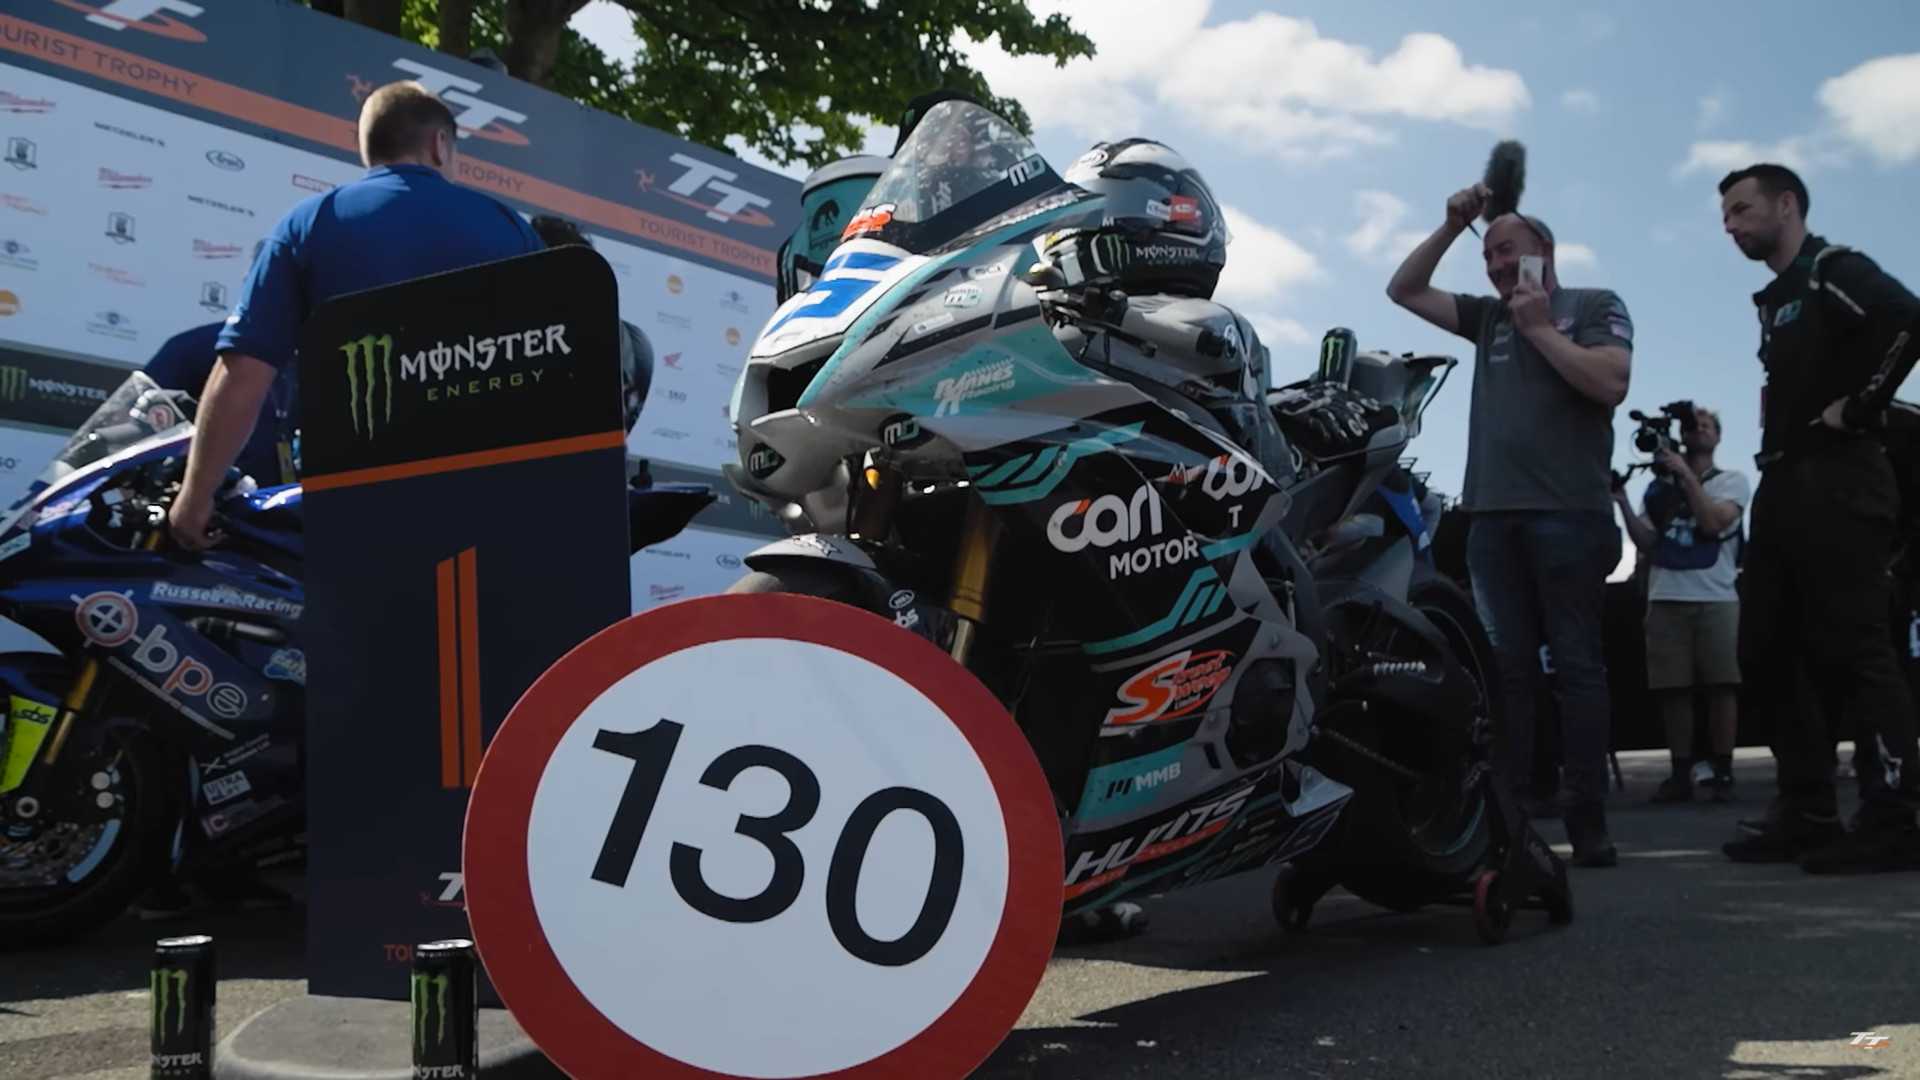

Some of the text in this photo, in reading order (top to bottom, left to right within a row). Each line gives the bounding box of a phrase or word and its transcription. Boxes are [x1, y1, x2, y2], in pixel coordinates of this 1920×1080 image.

[0, 24, 198, 94] URIST TROPHY
[458, 161, 526, 193] ROPHY
[668, 153, 772, 223] TT
[640, 217, 772, 268] TOURIST TROPHY
[400, 323, 572, 383] MONSTER
[427, 368, 545, 401] ENERGY
[1110, 536, 1199, 580] MOTOR
[132, 624, 248, 718] bpe
[1135, 762, 1182, 791] MMB
[589, 718, 964, 968] 130
